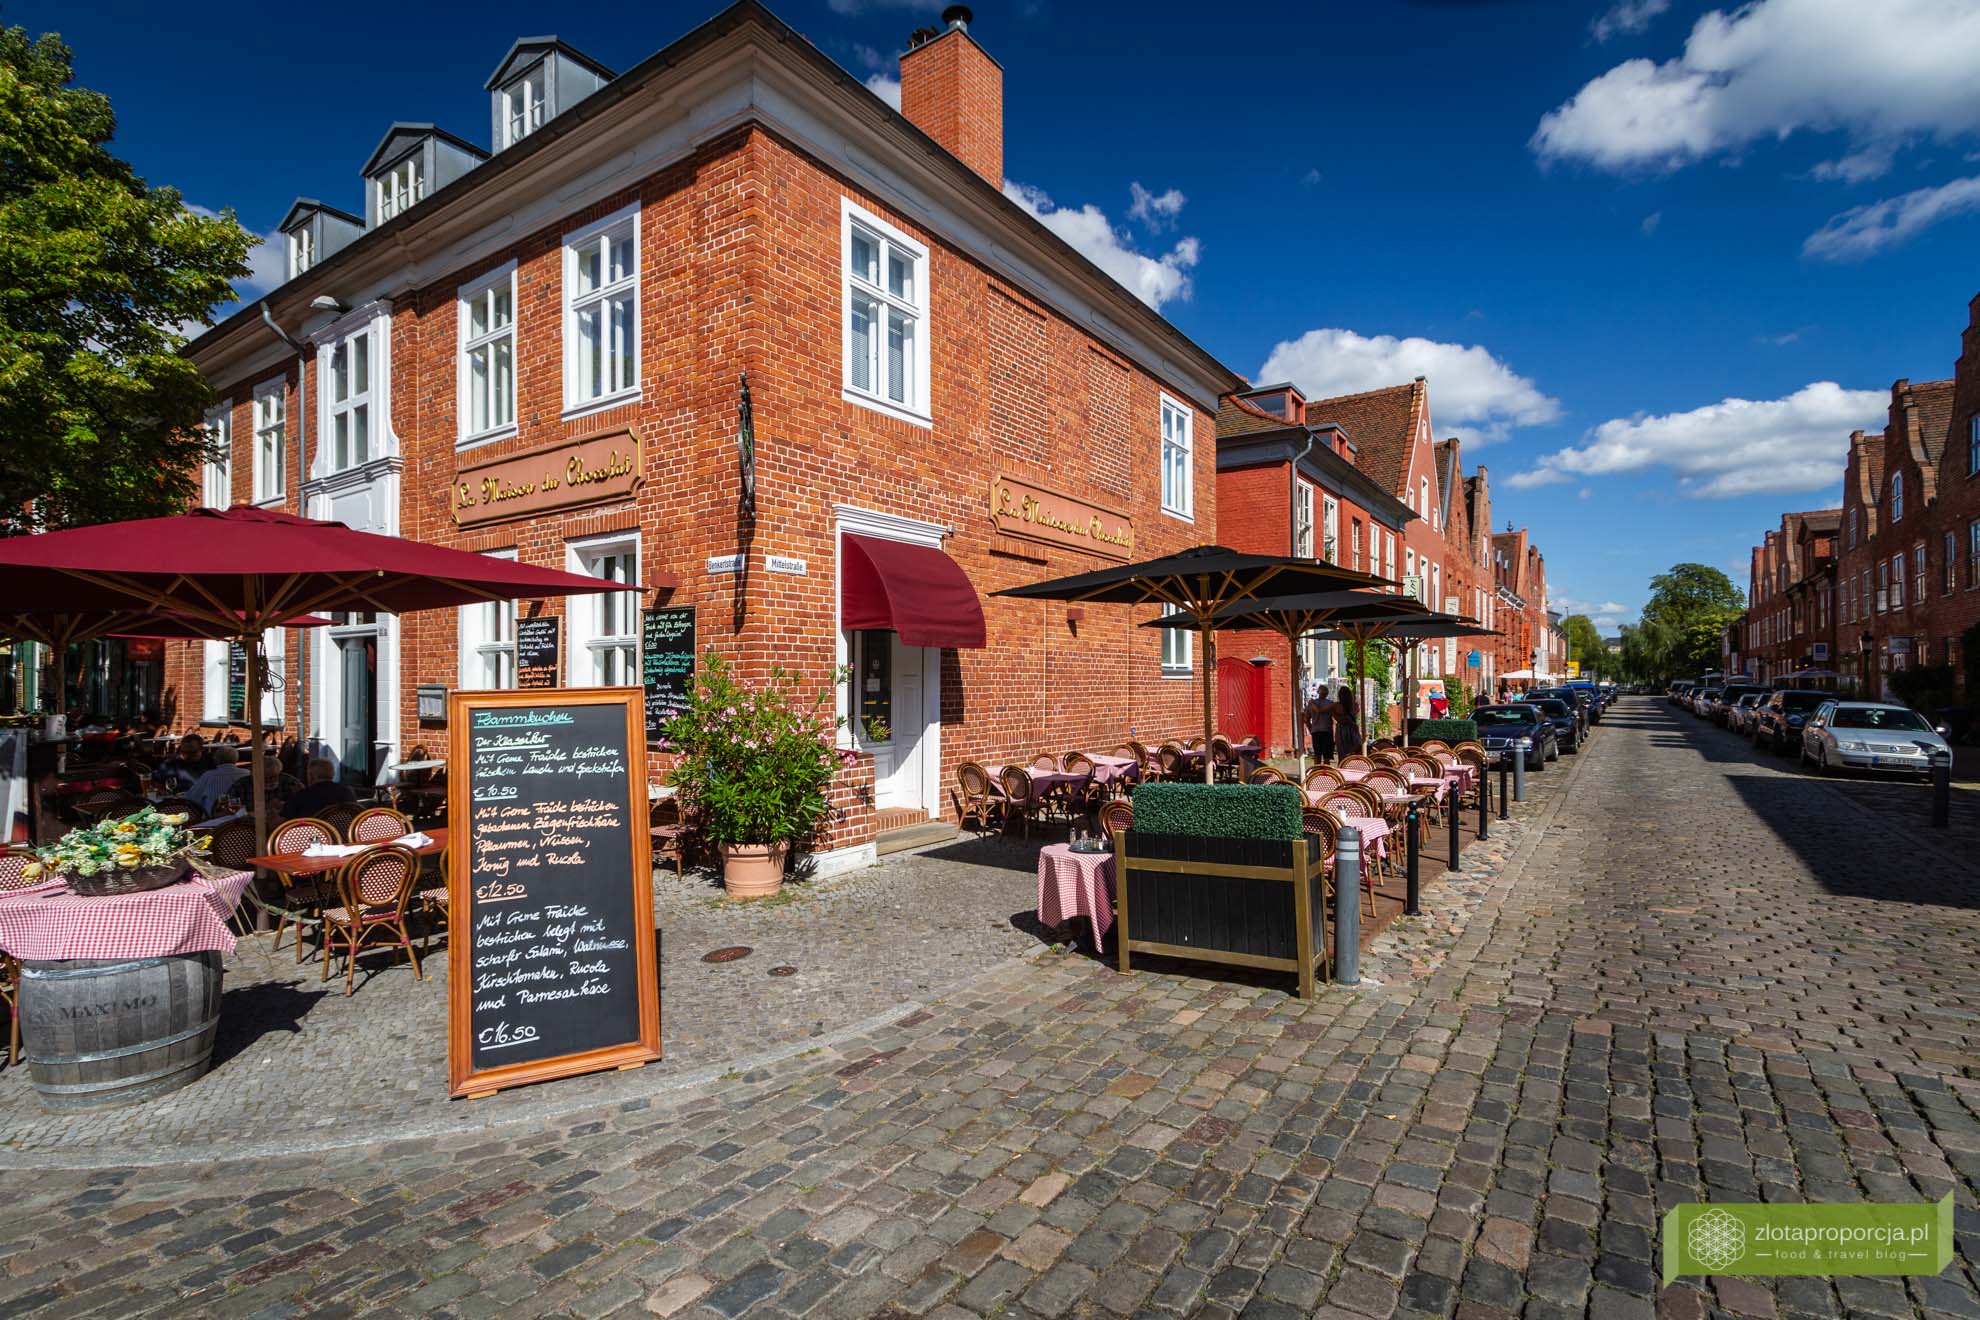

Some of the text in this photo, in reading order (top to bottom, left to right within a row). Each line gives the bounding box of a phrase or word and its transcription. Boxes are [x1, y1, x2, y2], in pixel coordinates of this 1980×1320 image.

[457, 450, 632, 509] La Maison du Chocolat
[997, 488, 1020, 519] La
[1021, 494, 1073, 533] Maison
[1090, 515, 1132, 548] Chocolat
[771, 558, 803, 571] Mittelstraße
[475, 711, 573, 727] Flammkuchen
[476, 731, 551, 747] Der Klassiker
[475, 753, 494, 764] Mit
[530, 749, 567, 762] Fraiche
[572, 746, 619, 759] bestrichen
[522, 763, 554, 775] Lauch
[558, 763, 576, 773] und
[576, 760, 625, 779] Speckstreifen
[475, 806, 498, 819] Mit
[570, 799, 620, 813] bestrichen
[473, 851, 586, 876] Honig und Rucola
[475, 880, 525, 899] €12.50
[476, 912, 503, 930] Mit
[544, 905, 589, 919] Fraiche
[476, 919, 606, 948] bestrichen belegt mit
[475, 949, 522, 968] scharfer
[525, 943, 568, 960] Salami,
[473, 959, 611, 994] Kirschtomaten, Rucola
[62, 994, 158, 1019] MAXIMO
[475, 995, 507, 1012] und
[478, 1021, 537, 1044] €16.50
